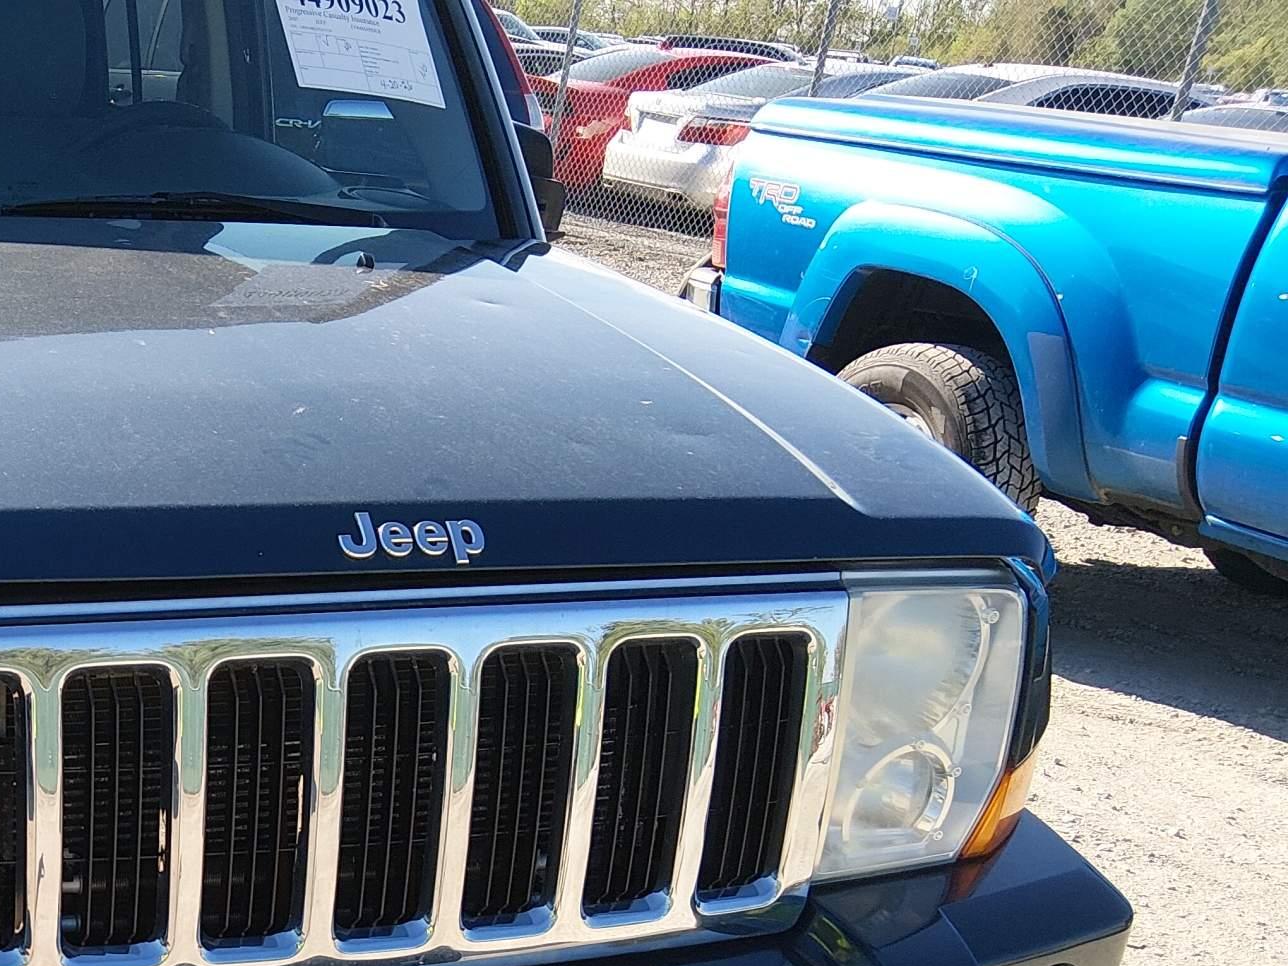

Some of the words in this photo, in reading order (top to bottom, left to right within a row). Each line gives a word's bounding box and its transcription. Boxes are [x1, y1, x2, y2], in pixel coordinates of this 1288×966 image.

[275, 118, 322, 128] CR-V
[749, 177, 801, 206] TRD
[777, 204, 805, 215] OFF
[781, 215, 817, 229] ROAD
[337, 511, 486, 565] Jeep
